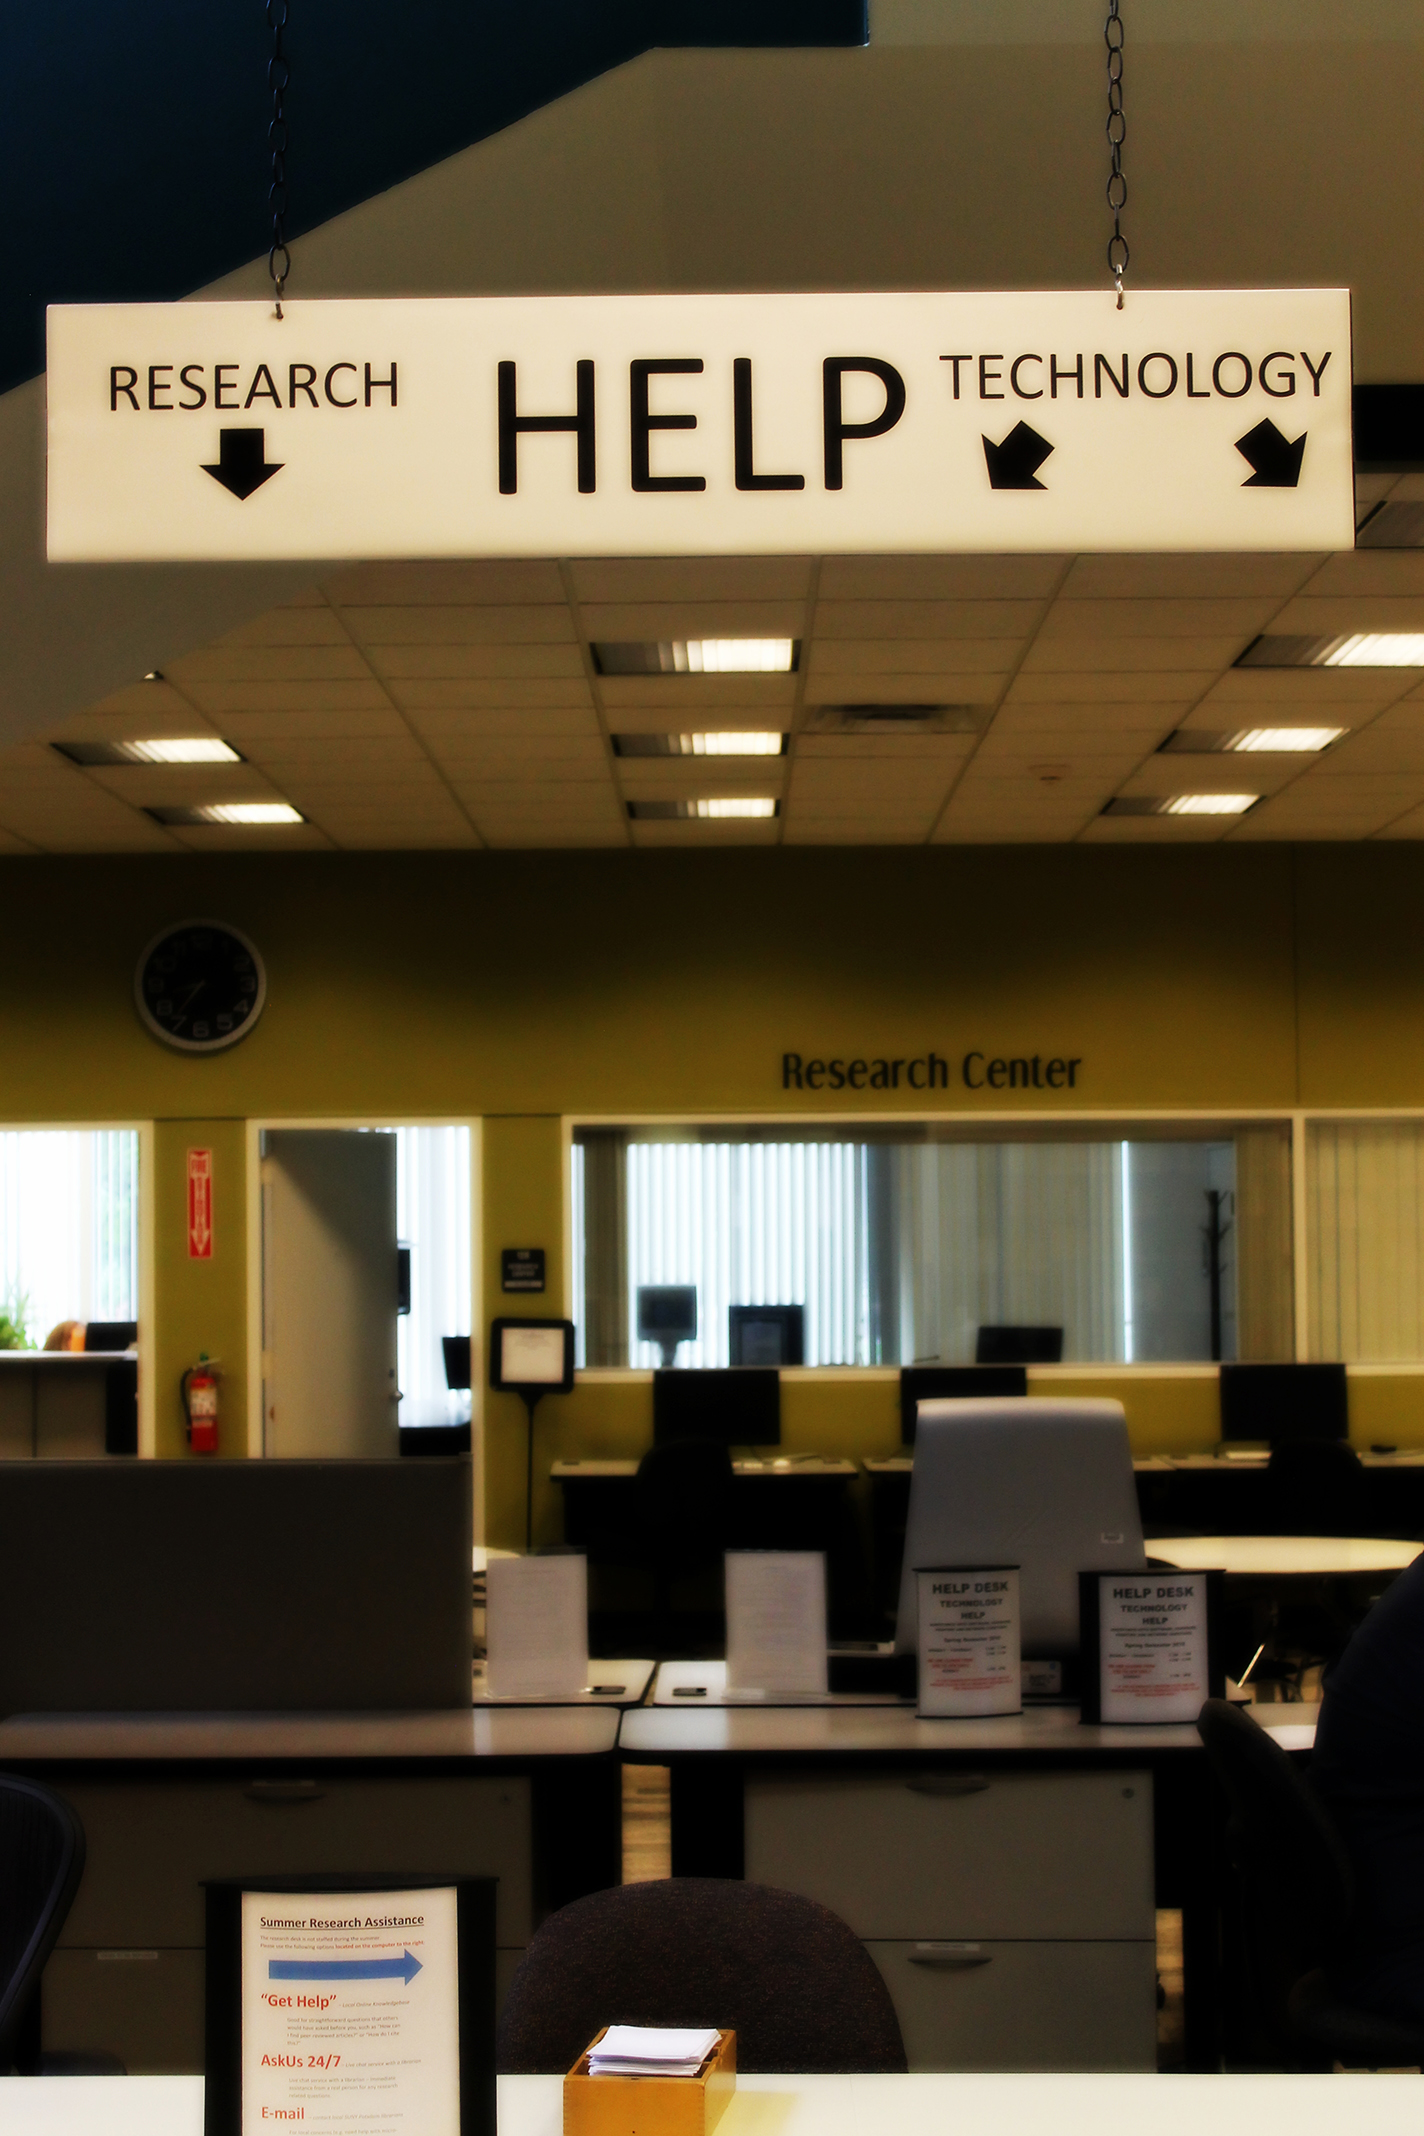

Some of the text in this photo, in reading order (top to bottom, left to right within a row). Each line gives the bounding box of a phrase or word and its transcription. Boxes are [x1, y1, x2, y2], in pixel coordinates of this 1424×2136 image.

[939, 351, 1332, 400] TECHNOLOGY
[110, 361, 398, 412] RESEARCH
[497, 356, 907, 495] HELP
[782, 1050, 1083, 1090] Research Center
[932, 1581, 1009, 1594] HELP DESK
[1113, 1586, 1195, 1599] HELP DESK
[940, 1599, 1003, 1608] TECHNOLOGY
[1121, 1604, 1188, 1613] TECHNOLOGY
[961, 1611, 986, 1620] HELP
[1142, 1616, 1169, 1625] HELP
[260, 1915, 424, 1929] Summer Research Assistance
[260, 1994, 337, 2010] “Get Help”
[260, 2054, 341, 2070] AskUs 24/7
[262, 2106, 304, 2120] E-mail
